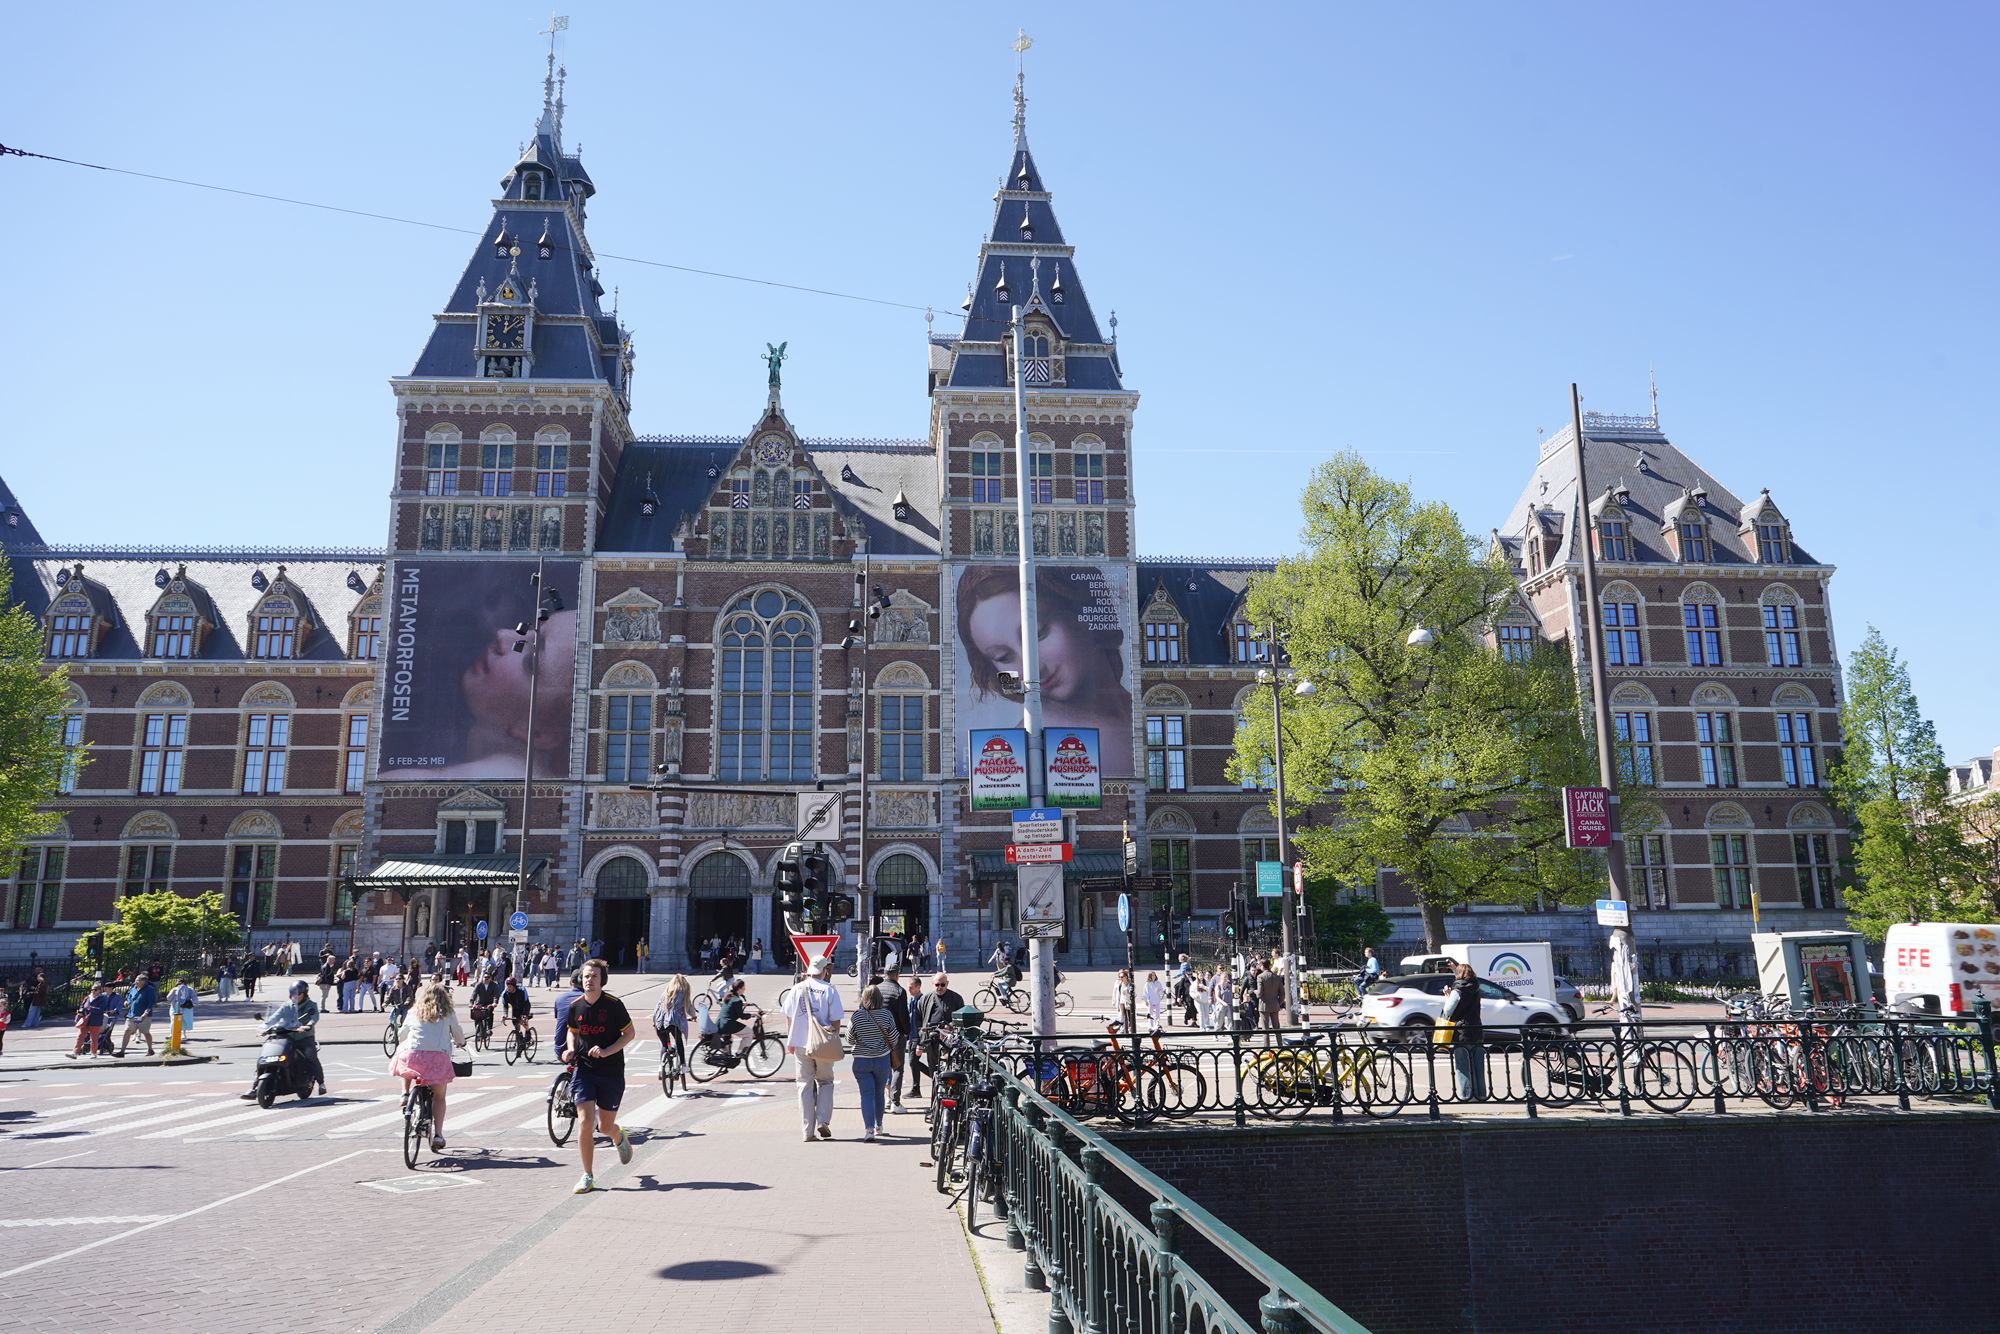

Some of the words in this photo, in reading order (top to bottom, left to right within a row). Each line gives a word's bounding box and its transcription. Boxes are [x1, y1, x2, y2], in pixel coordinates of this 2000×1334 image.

[392, 568, 420, 721] METAMORFOSEN
[979, 757, 1017, 766] MAGIC
[1054, 756, 1090, 765] MAGIC
[974, 766, 1024, 775] MUSHROOM
[1049, 764, 1097, 773] MUSHROOM
[1577, 800, 1604, 812] JACK
[1898, 948, 1930, 967] EFE
[1499, 979, 1534, 987] REGENBOOG
